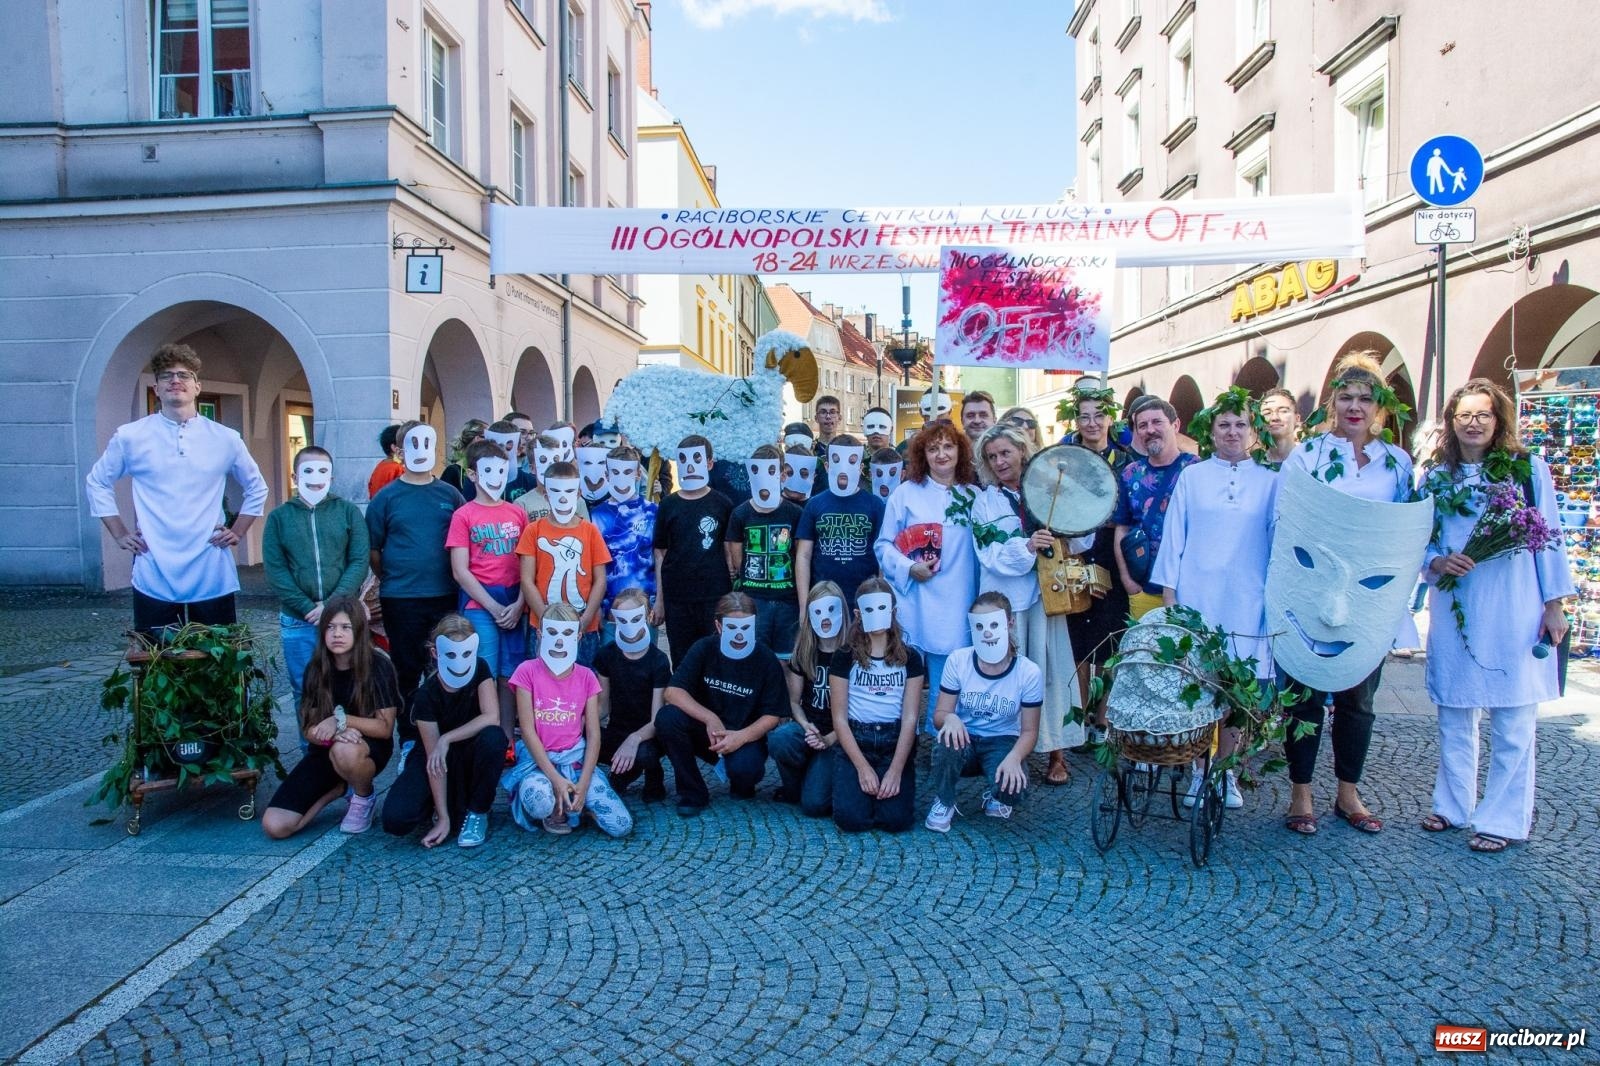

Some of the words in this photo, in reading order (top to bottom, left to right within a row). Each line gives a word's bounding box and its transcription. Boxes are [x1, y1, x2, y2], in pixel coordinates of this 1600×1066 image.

[675, 209, 828, 224] RACIBORSKIE
[842, 208, 961, 225] CENTRUM
[981, 206, 1097, 222] KULTURY
[1418, 212, 1434, 220] Nie
[1437, 211, 1473, 220] dotyczy
[611, 226, 639, 250] III
[643, 226, 868, 250] OGÓLNOPOLSKI
[876, 223, 1000, 246] FESTIWAL
[1003, 219, 1140, 244] TEATRALNY
[752, 251, 819, 272] 18-24
[980, 270, 1068, 284] FESTIWAL
[967, 285, 1086, 301] TEATRALNY
[816, 513, 872, 527] STAR
[816, 525, 872, 540] WARS
[180, 742, 201, 756] JBL
